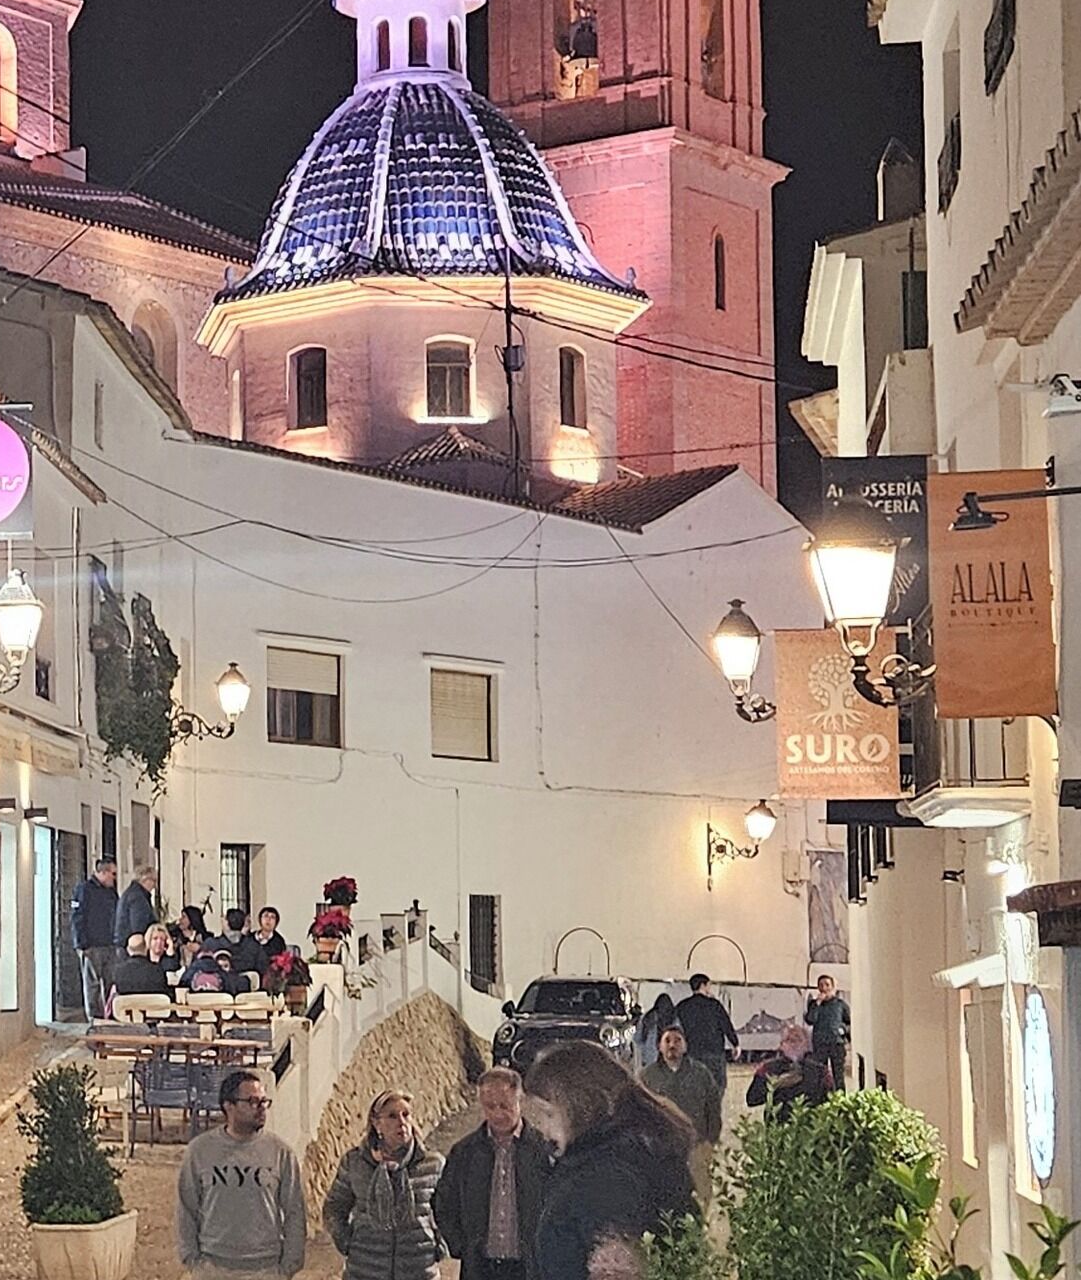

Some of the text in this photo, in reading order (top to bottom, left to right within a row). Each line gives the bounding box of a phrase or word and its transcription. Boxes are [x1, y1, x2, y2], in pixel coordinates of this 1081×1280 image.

[951, 561, 1034, 604] ALALA
[785, 733, 890, 764] SURO
[212, 1165, 272, 1187] NYC
